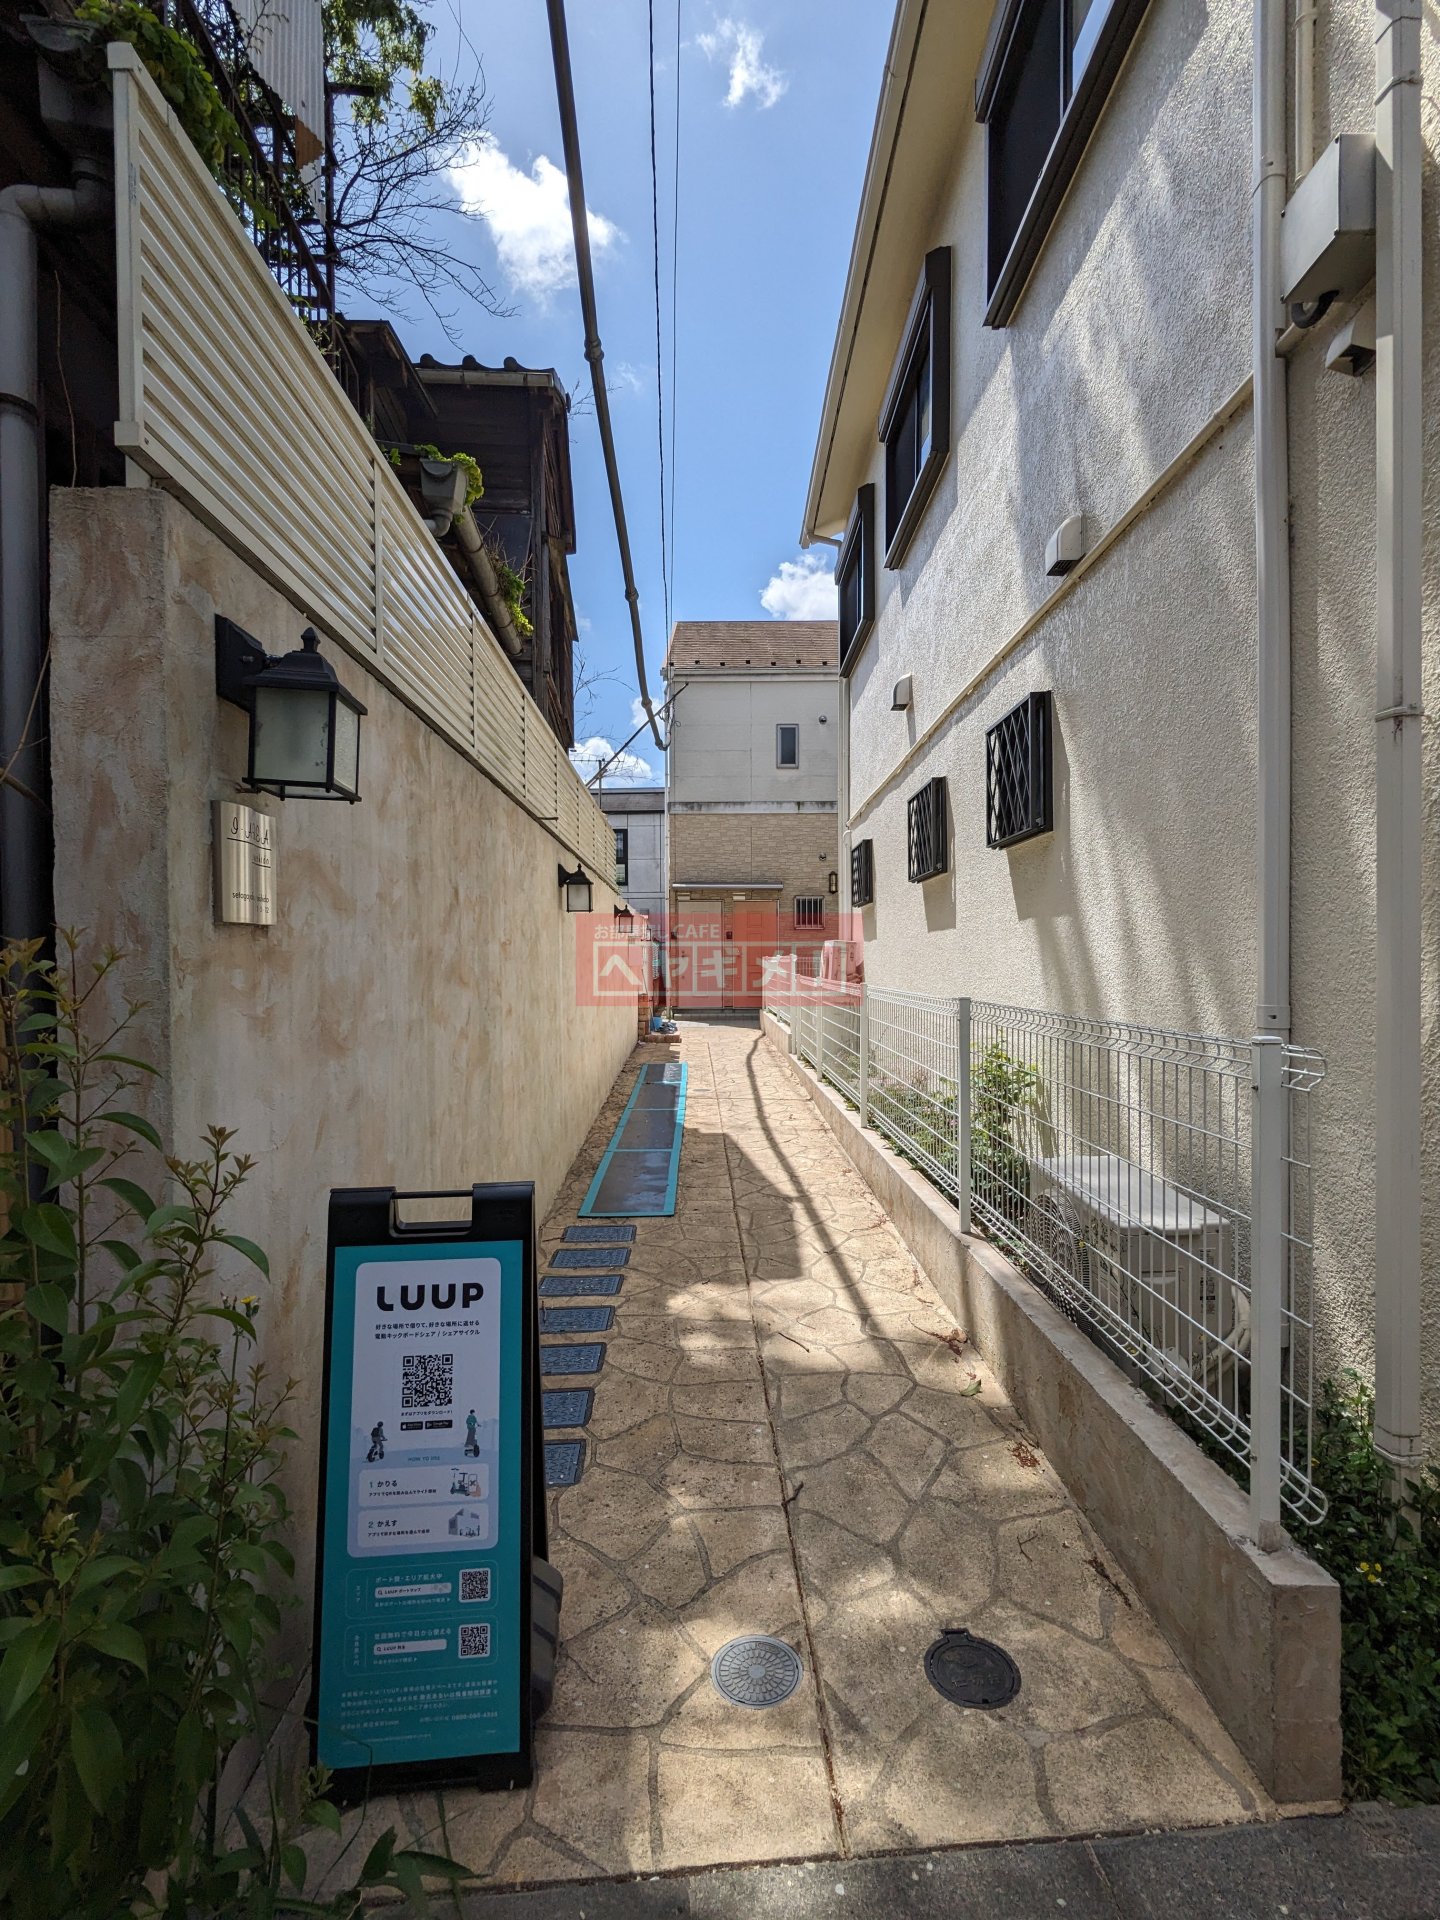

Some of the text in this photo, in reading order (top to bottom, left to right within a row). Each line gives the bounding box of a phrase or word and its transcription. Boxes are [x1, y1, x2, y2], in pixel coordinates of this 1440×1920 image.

[376, 1282, 484, 1312] LUUP
[377, 1480, 398, 1488] かりる
[367, 1520, 398, 1529] 2 かえす
